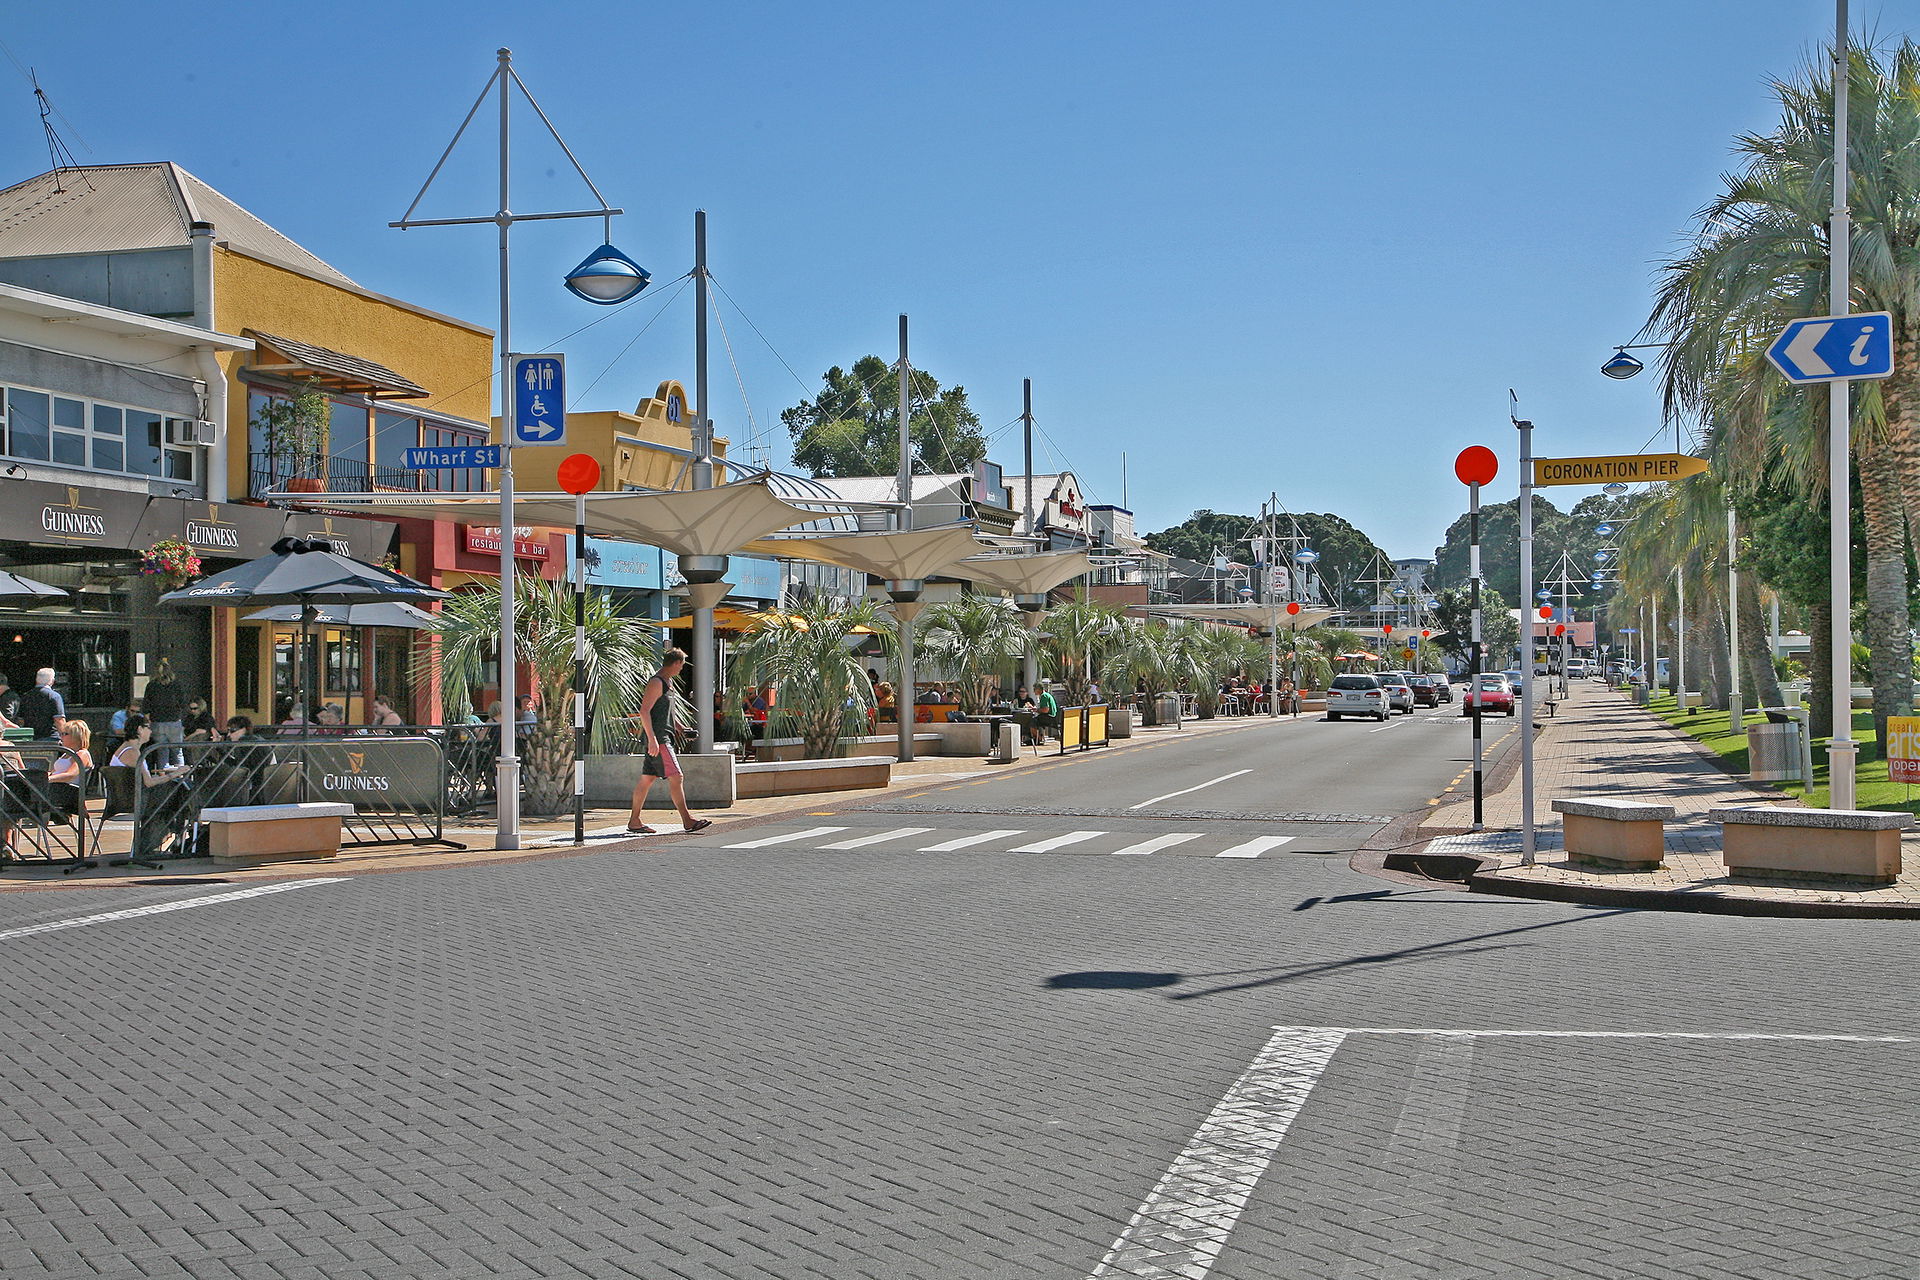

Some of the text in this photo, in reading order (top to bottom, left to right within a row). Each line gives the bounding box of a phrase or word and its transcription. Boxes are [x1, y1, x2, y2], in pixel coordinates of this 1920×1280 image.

[669, 394, 681, 422] 81
[413, 449, 494, 465] Wharf St
[1543, 460, 1679, 479] CORONATION PIER
[522, 544, 527, 553] &
[532, 544, 546, 555] bar
